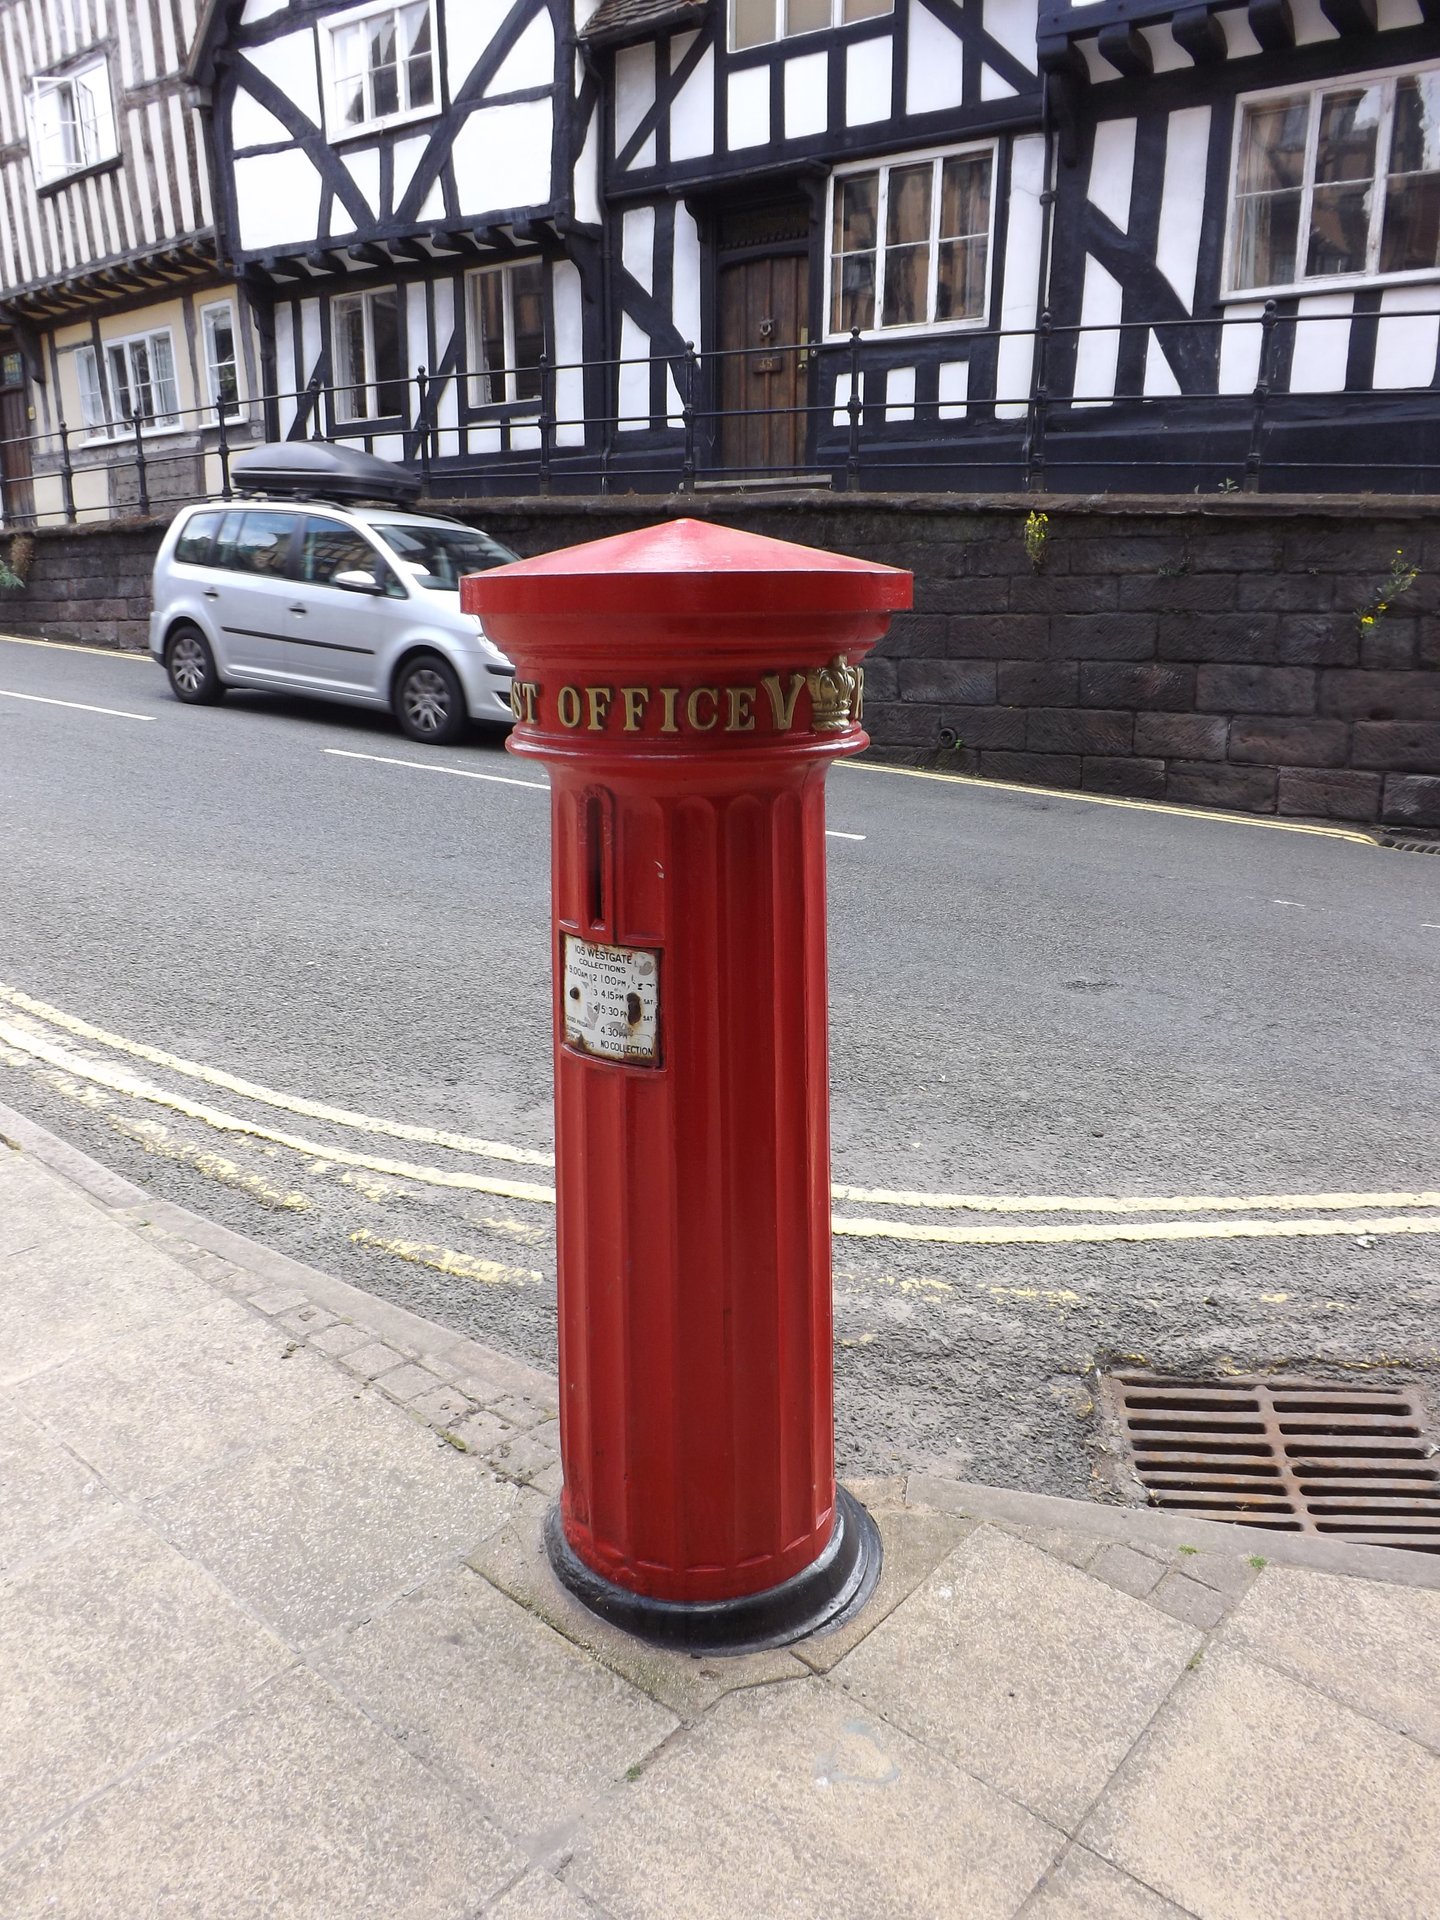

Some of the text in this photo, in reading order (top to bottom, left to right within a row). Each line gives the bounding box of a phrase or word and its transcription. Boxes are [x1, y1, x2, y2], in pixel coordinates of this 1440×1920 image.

[557, 686, 757, 732] OFFICE
[760, 673, 806, 730] V
[575, 945, 632, 964] 105 WESTGATE
[578, 958, 627, 974] COLLECTIONS
[600, 1040, 610, 1050] NO
[610, 1042, 653, 1055] COLLECTION
